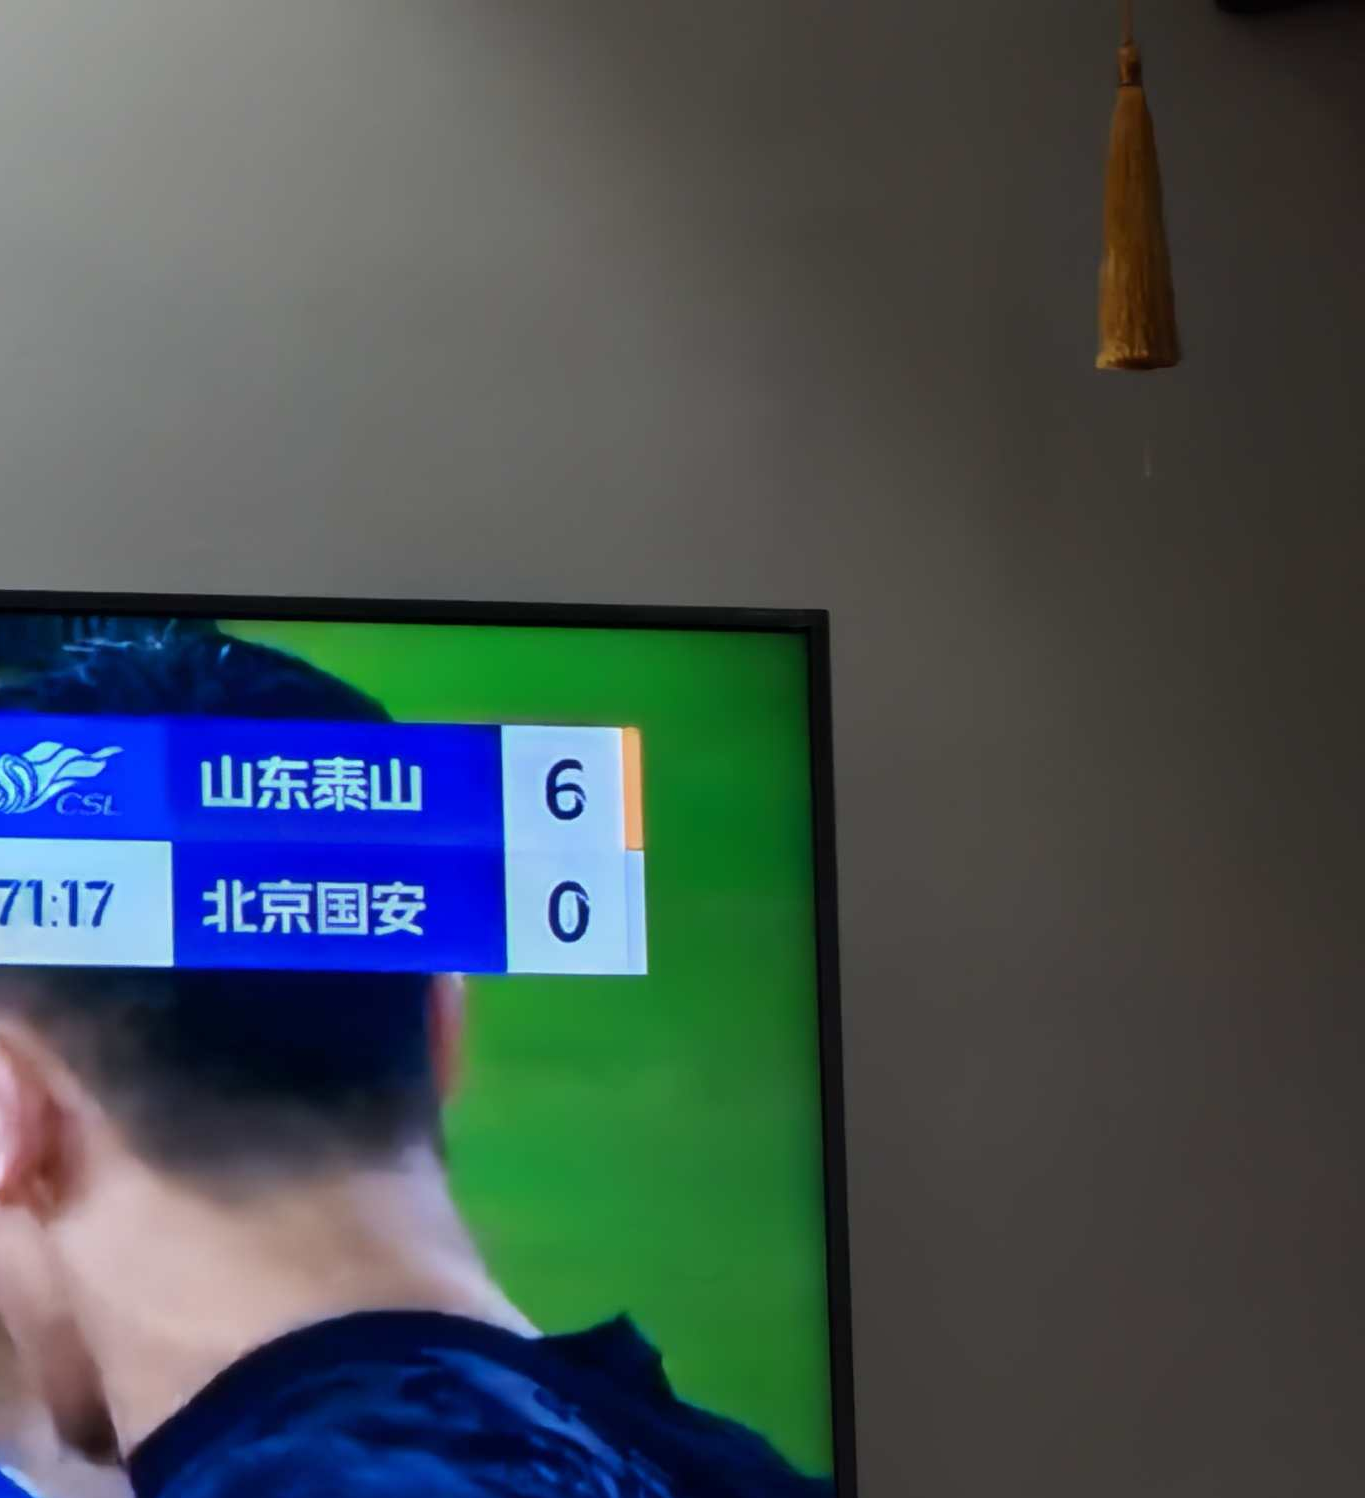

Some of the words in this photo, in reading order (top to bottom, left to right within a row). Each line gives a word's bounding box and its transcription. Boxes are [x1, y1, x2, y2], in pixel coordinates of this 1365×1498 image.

[54, 791, 123, 817] CSL
[200, 754, 423, 812] 山东泰山
[544, 757, 587, 821] 6
[202, 878, 427, 937] 北京国安
[547, 879, 591, 944] 0
